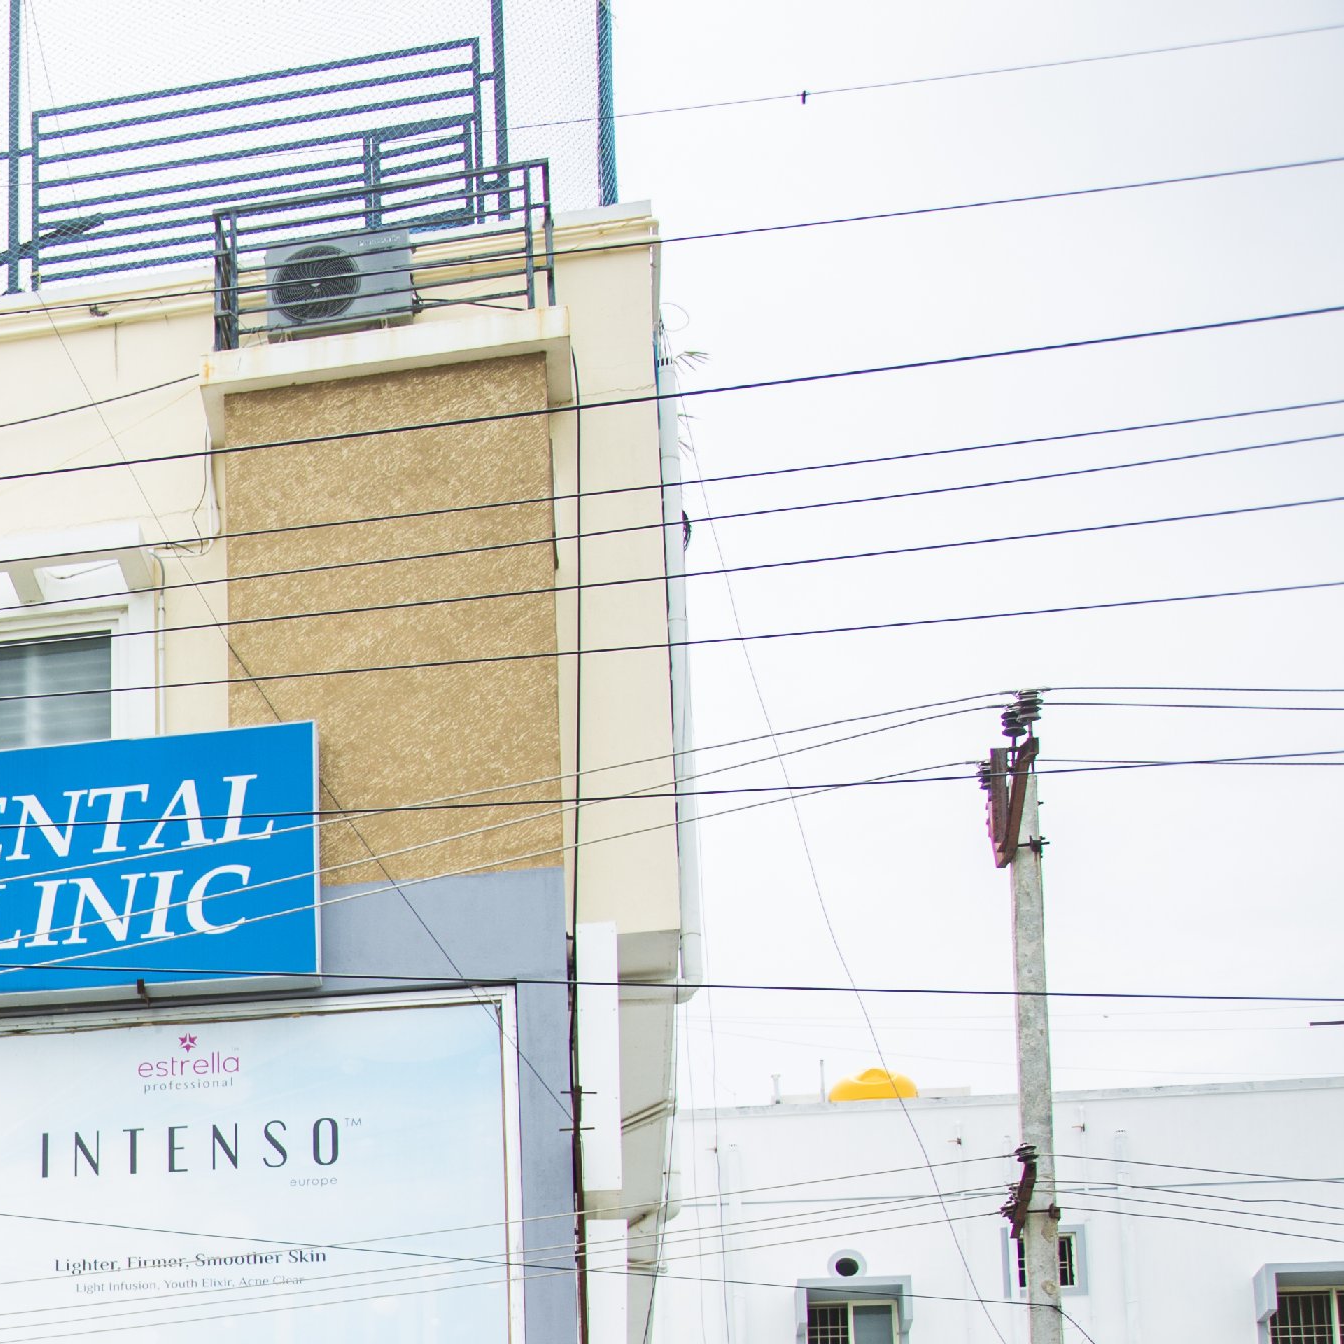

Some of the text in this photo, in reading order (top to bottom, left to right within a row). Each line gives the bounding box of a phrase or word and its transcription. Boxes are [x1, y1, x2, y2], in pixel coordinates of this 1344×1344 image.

[138, 1051, 240, 1078] estrella
[143, 1077, 234, 1095] professional
[41, 1117, 340, 1179] INTENSO
[290, 1175, 338, 1188] europe
[55, 1250, 327, 1275] Lighter, Firmer, Smoother Skin
[75, 1276, 269, 1295] Light Infusion, Youth Acne
